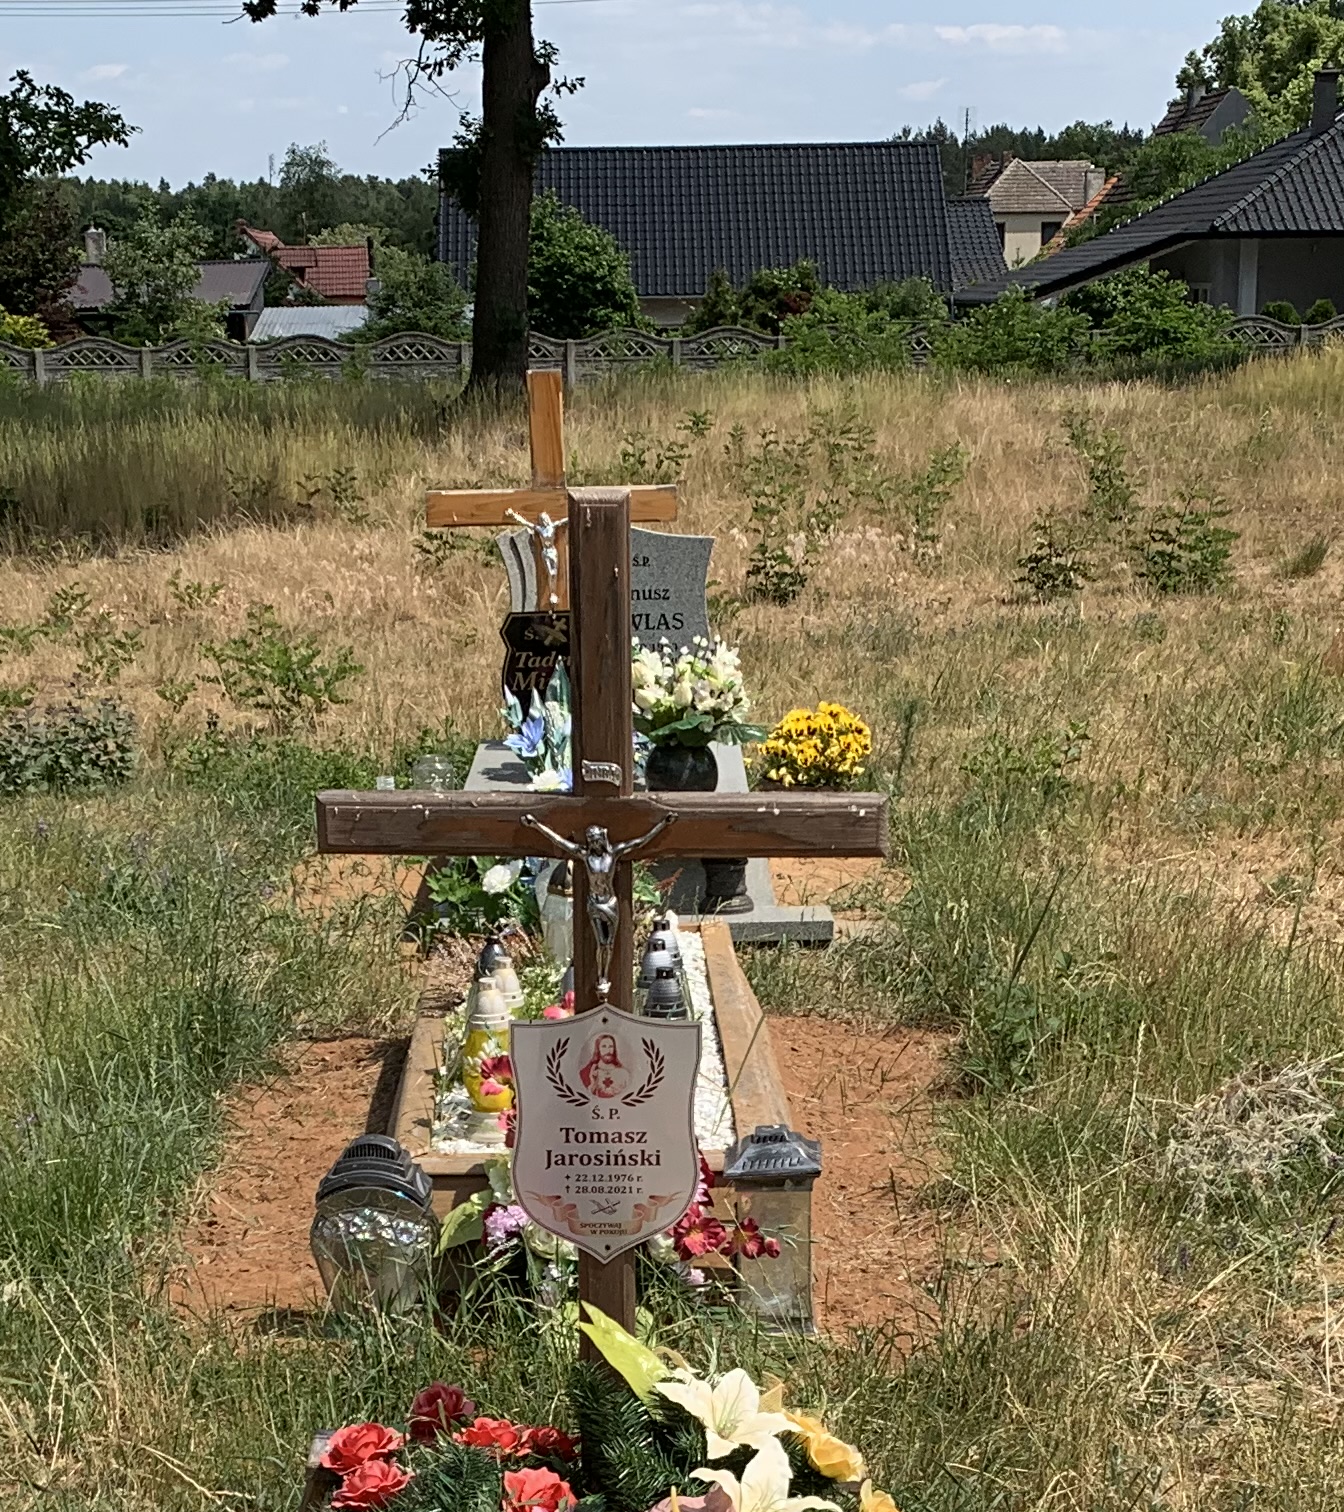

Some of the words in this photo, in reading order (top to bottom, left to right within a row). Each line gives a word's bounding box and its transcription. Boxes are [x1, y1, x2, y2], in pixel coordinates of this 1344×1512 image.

[631, 588, 670, 601] nusz
[591, 1105, 604, 1120] Ś.
[608, 1108, 621, 1120] P.
[559, 1127, 648, 1144] Tomasz
[545, 1149, 661, 1170] Jarosiński
[575, 1174, 634, 1182] 22.12.1976
[575, 1186, 633, 1194] 28.08.2021
